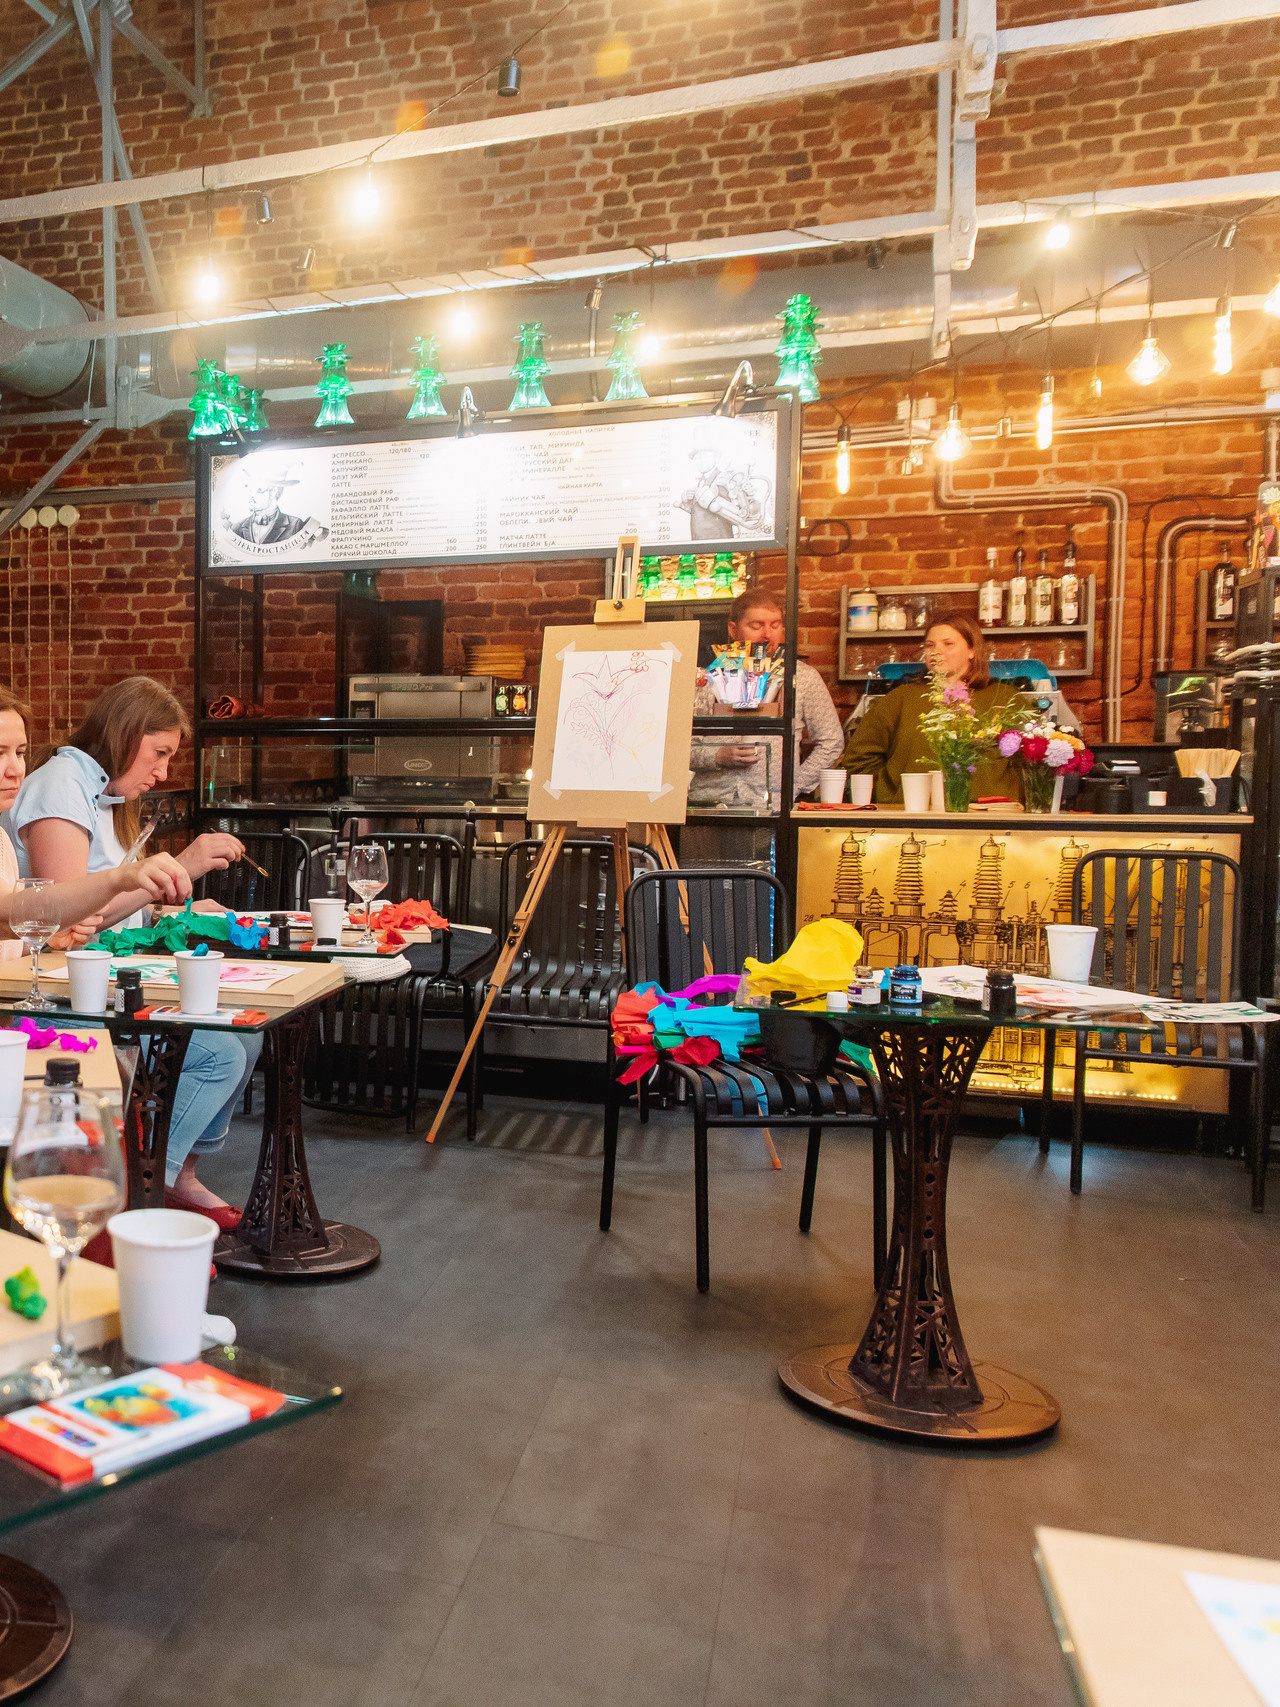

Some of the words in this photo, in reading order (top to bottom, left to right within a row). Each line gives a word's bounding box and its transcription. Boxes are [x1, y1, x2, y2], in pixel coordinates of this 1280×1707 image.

[548, 441, 585, 449] МИРИНДА
[331, 490, 377, 498] ЛАВАНДОВЫЙ
[331, 497, 383, 506] ФИСТАШКОВЫЙ
[331, 512, 378, 521] БЕЛЬГИЙСКИЙ
[499, 508, 560, 518] МАРОККАНСКИЙ
[499, 517, 554, 526] ОБЛЕПИВЫЙ
[360, 541, 409, 549] МАРШМЕЛЛОУ
[499, 541, 541, 549] ГЛИНТВЕЙН
[331, 550, 361, 558] ГОРЯЧИЙ
[1024, 881, 1031, 889] 6
